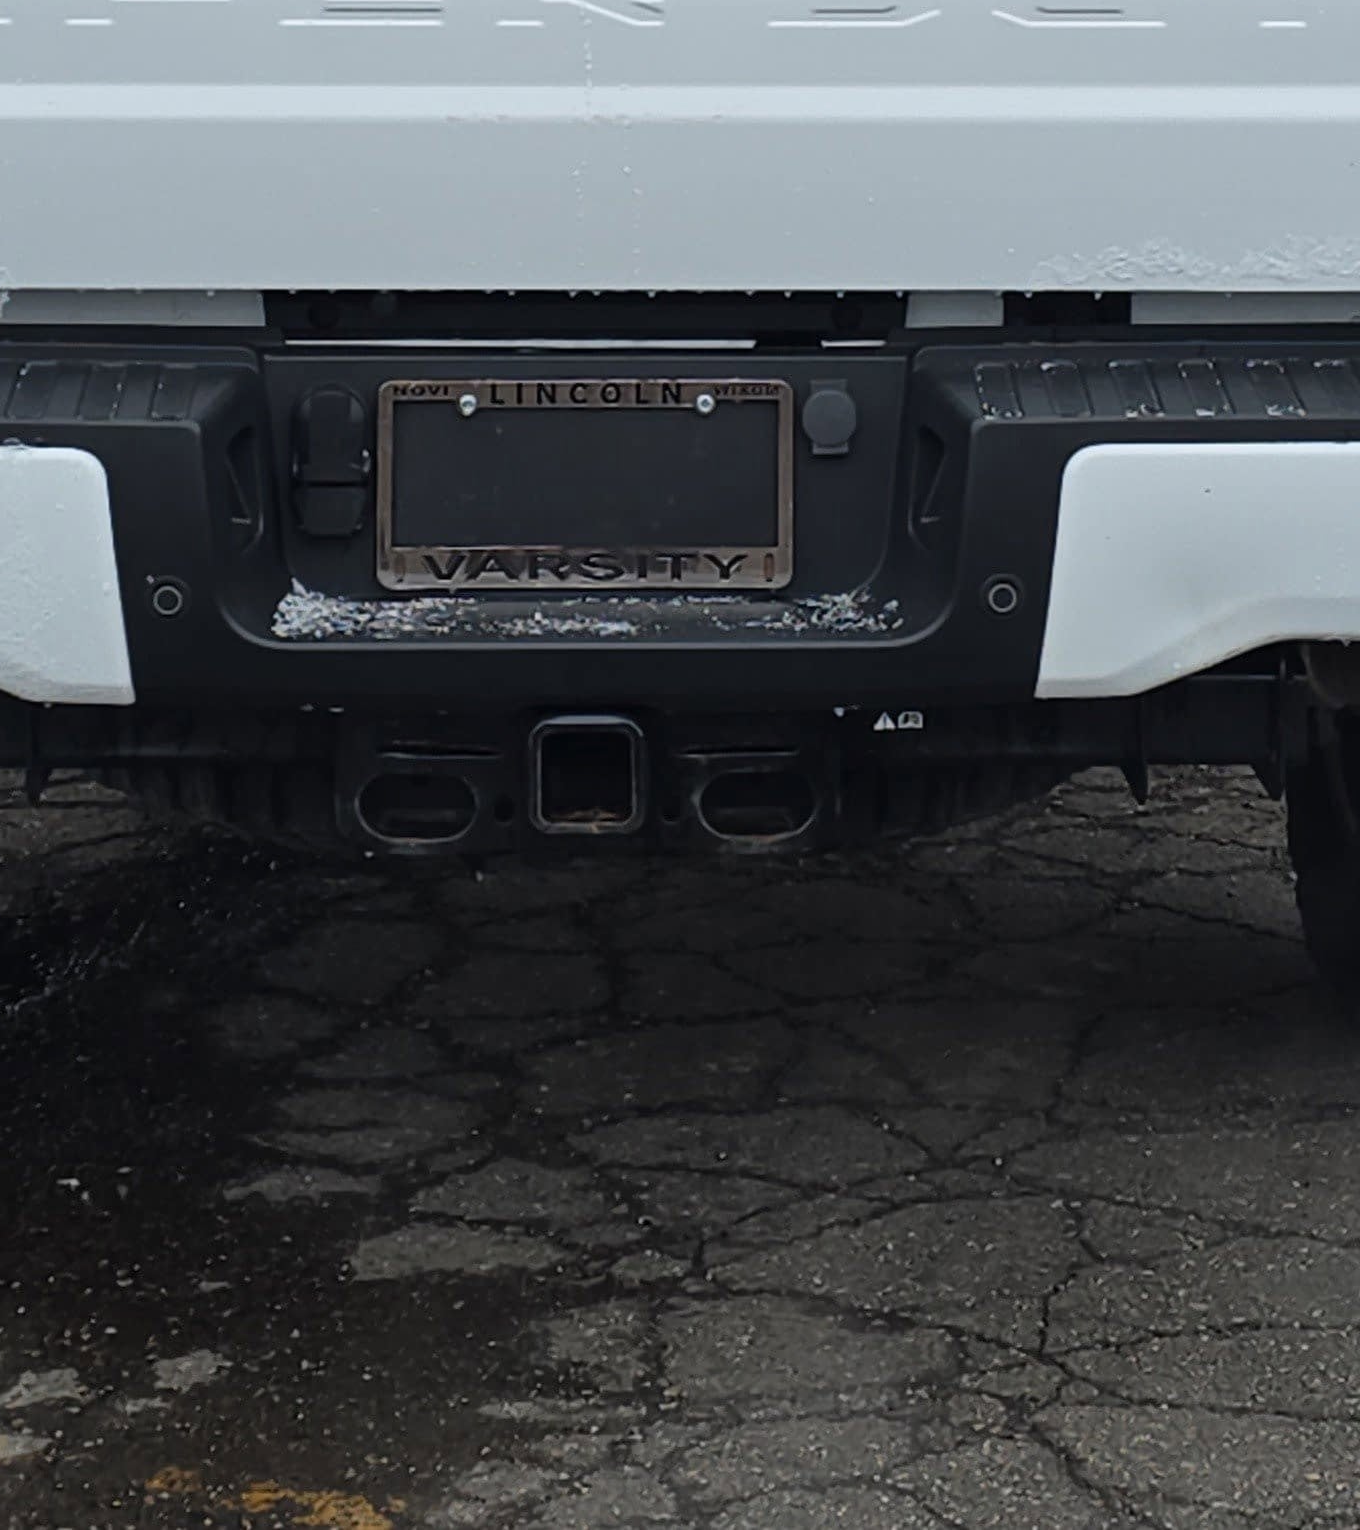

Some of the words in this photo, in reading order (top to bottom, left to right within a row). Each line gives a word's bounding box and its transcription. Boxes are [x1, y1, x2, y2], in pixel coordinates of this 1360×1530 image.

[392, 384, 450, 397] NOVI
[489, 381, 683, 406] LINCOLN
[421, 552, 748, 582] VARSITY
